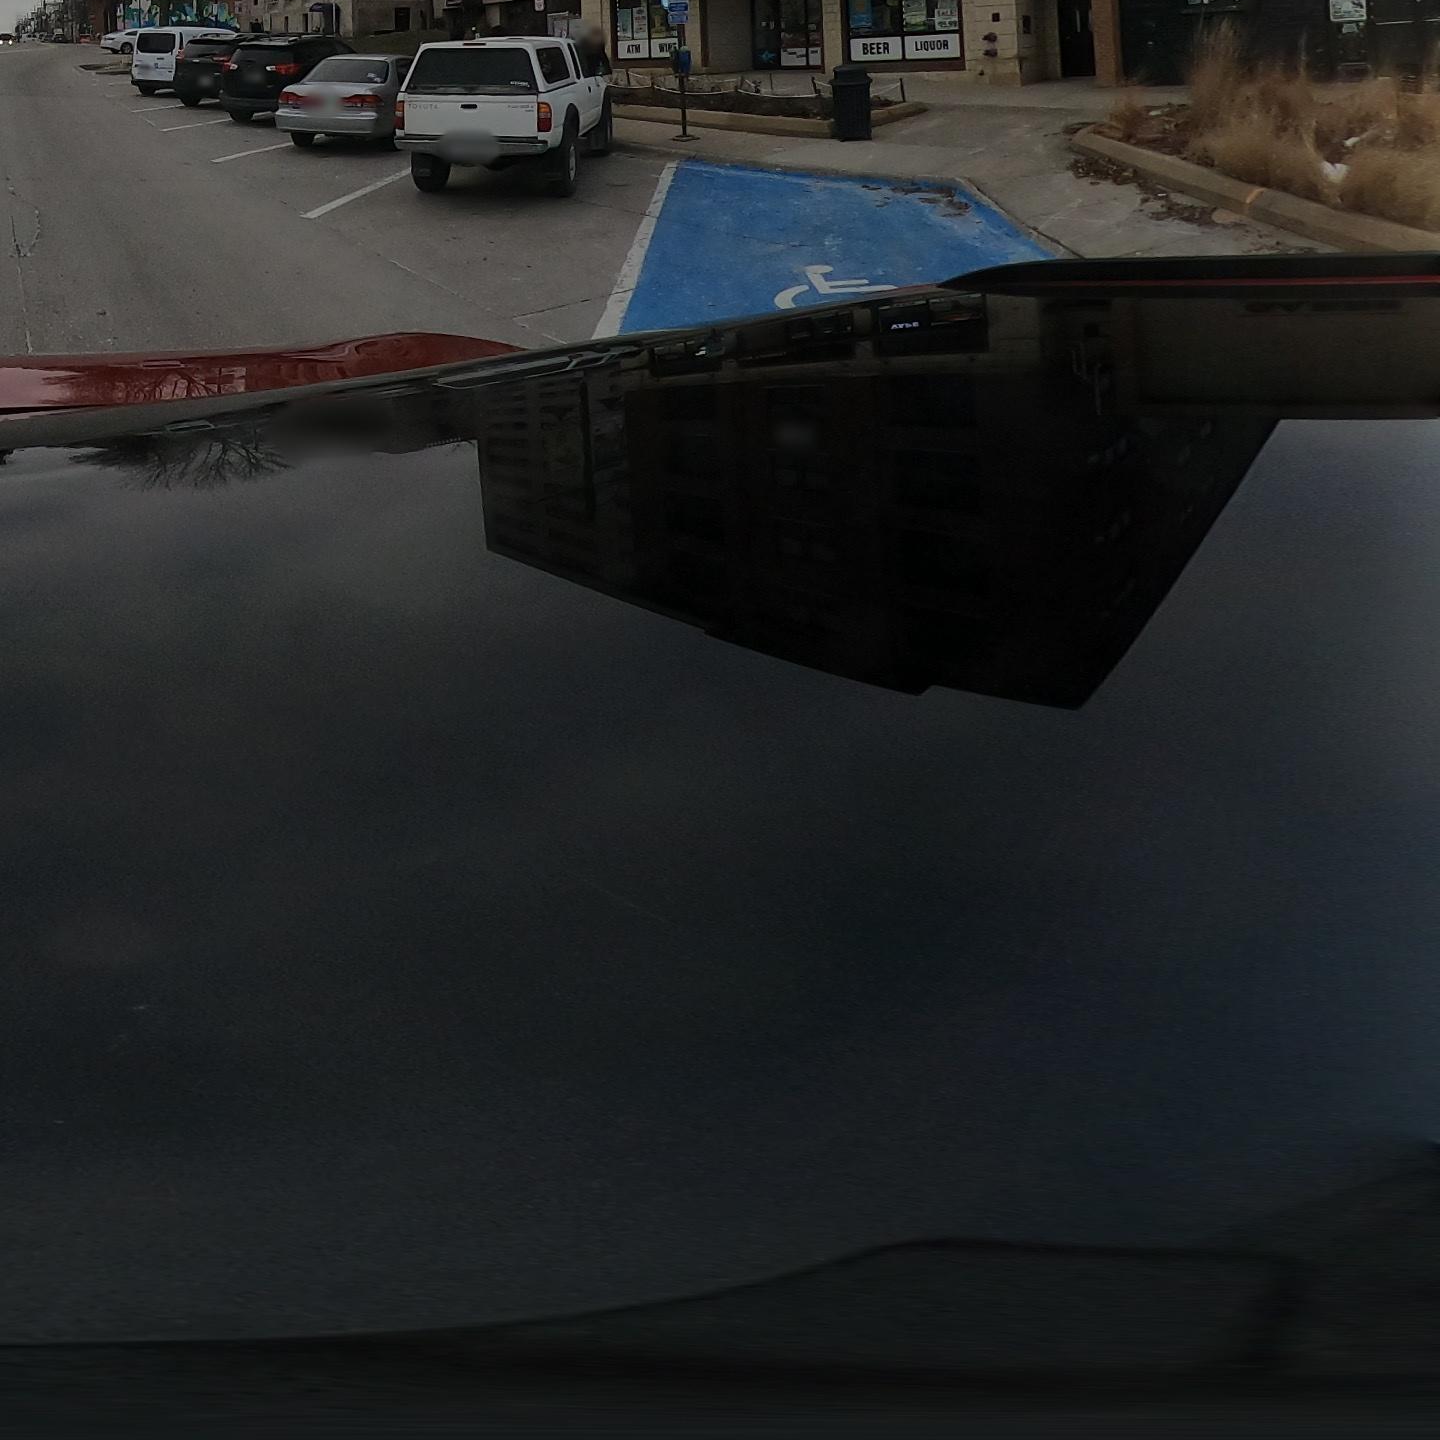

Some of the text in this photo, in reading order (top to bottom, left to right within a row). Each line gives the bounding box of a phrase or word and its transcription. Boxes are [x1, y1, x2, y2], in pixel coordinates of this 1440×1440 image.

[626, 44, 641, 55] ATM
[862, 42, 890, 56] BEER
[915, 40, 950, 52] LIQUOR
